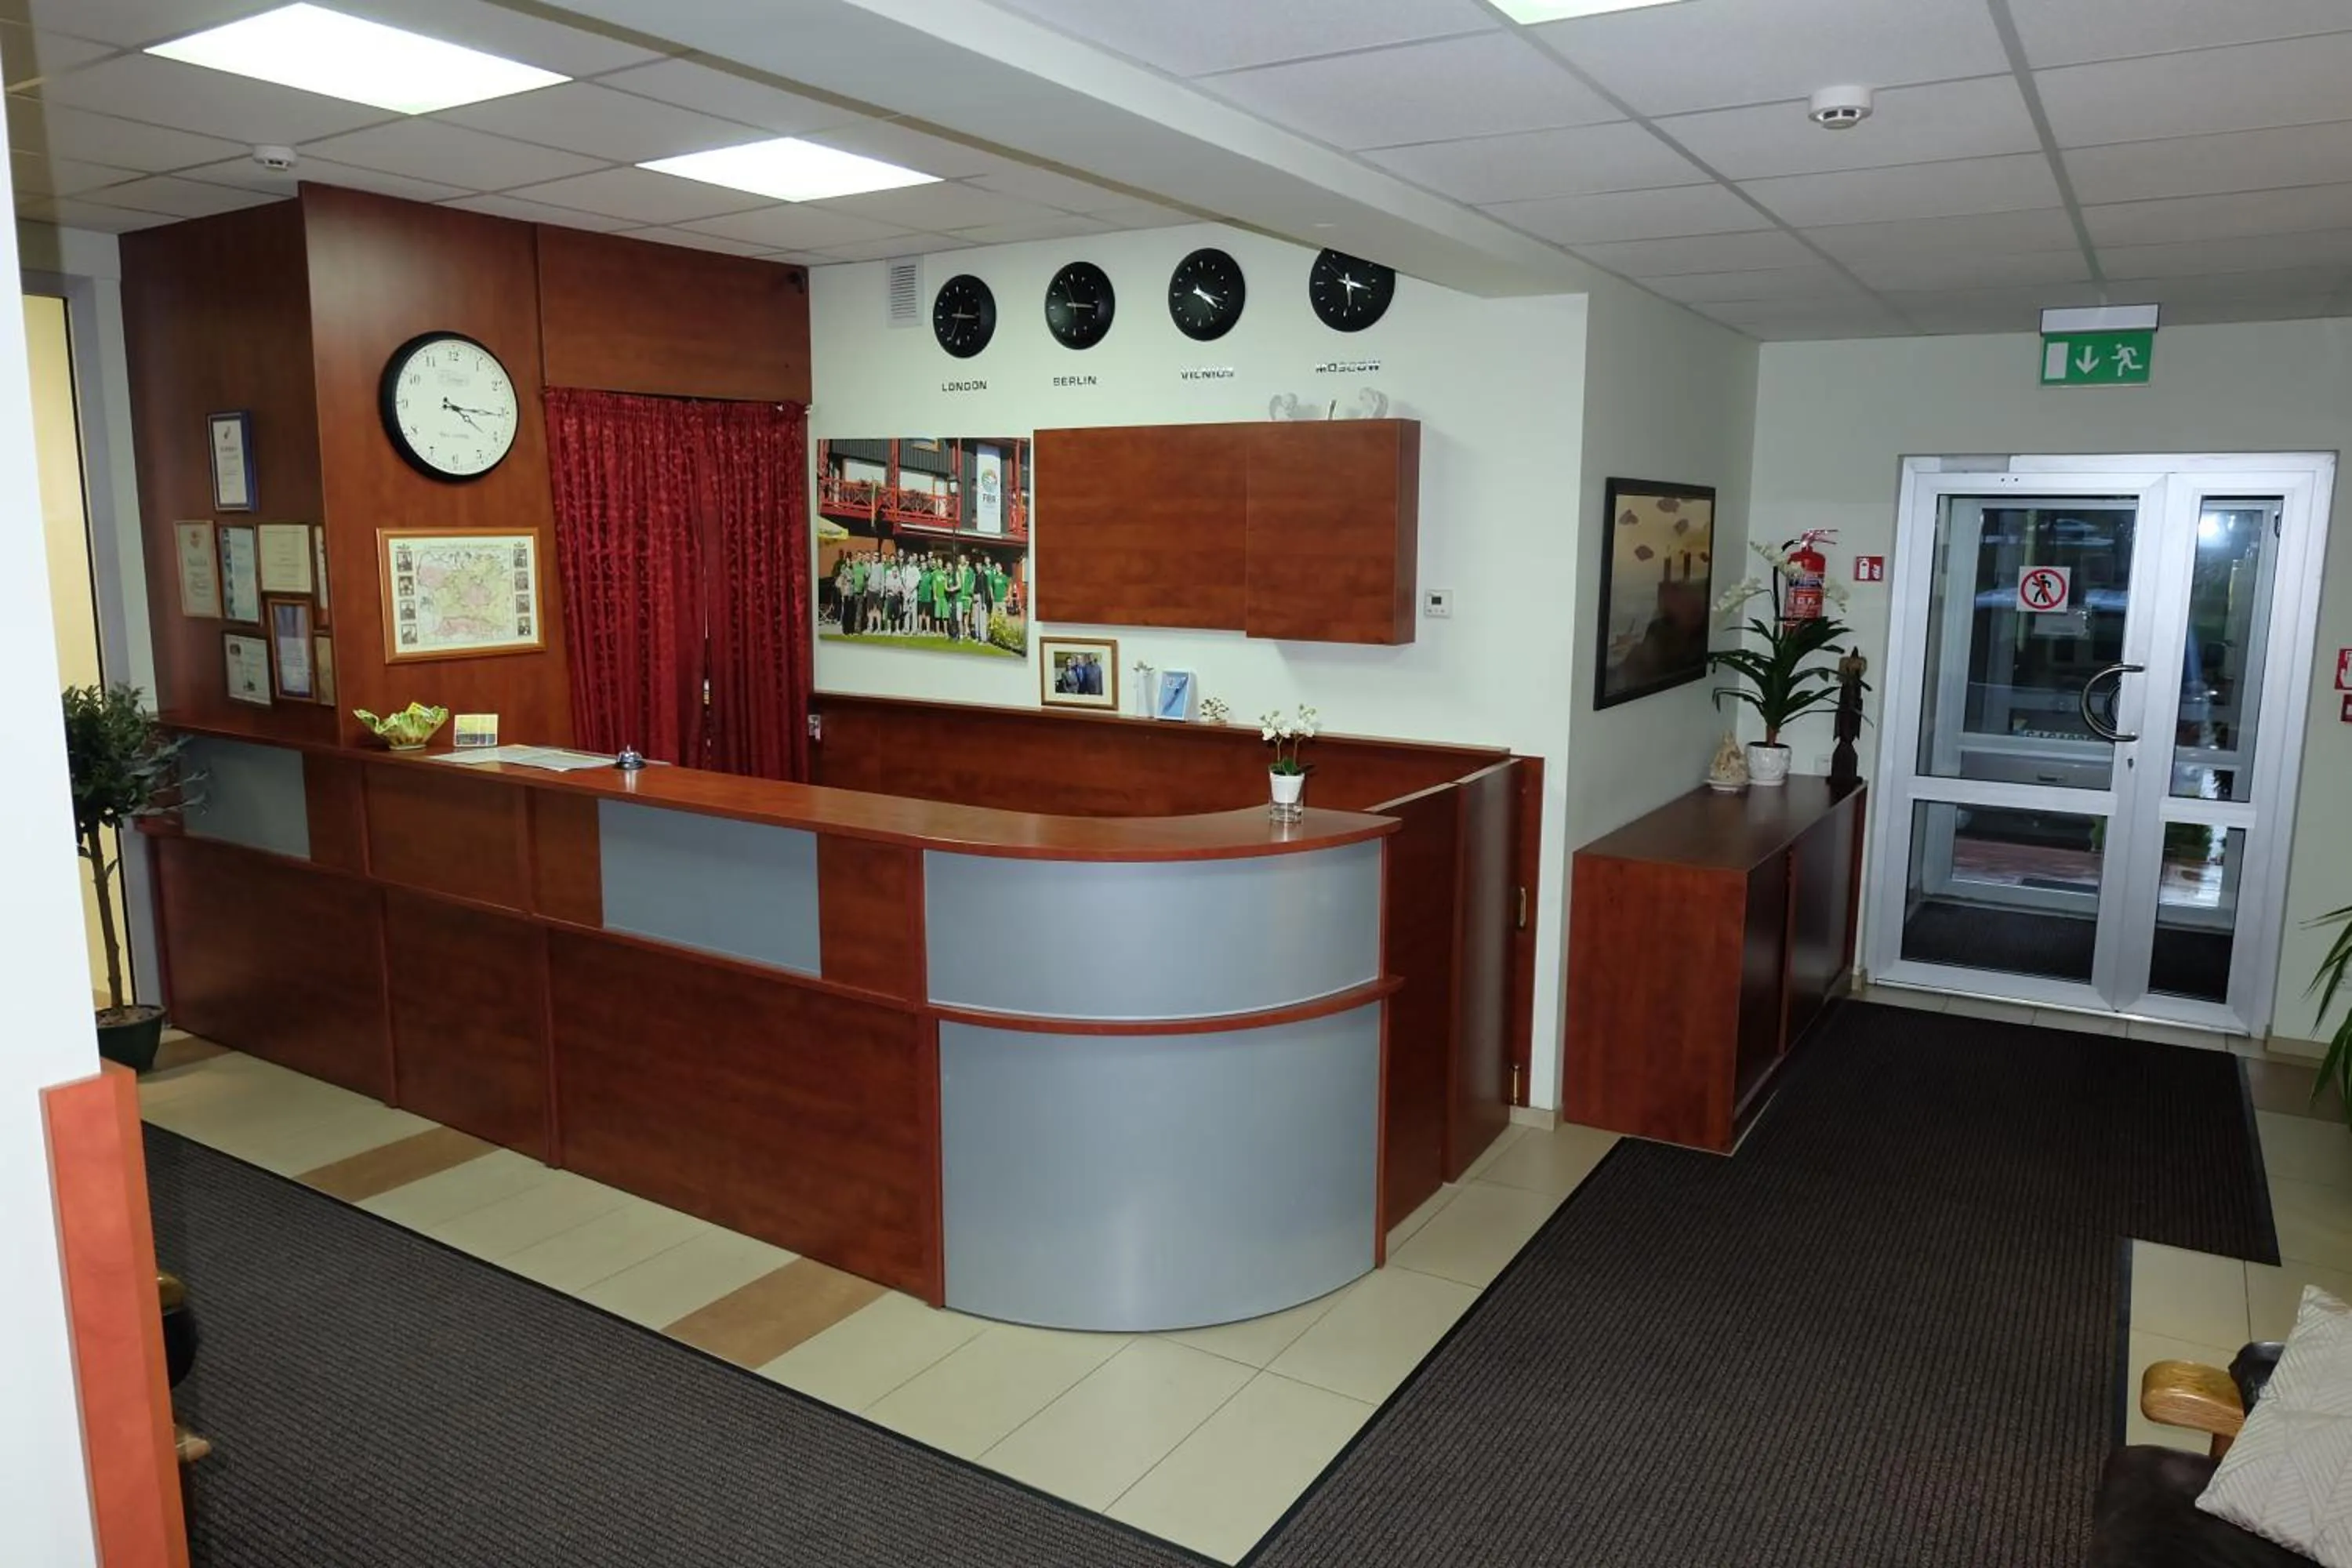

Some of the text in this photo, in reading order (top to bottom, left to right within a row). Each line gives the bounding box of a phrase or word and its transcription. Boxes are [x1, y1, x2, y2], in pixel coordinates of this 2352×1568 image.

[1180, 366, 1234, 379] VILNIUS
[1316, 360, 1380, 373] MOSCOW
[941, 380, 988, 392] LONDON
[1053, 376, 1097, 387] BERLIN
